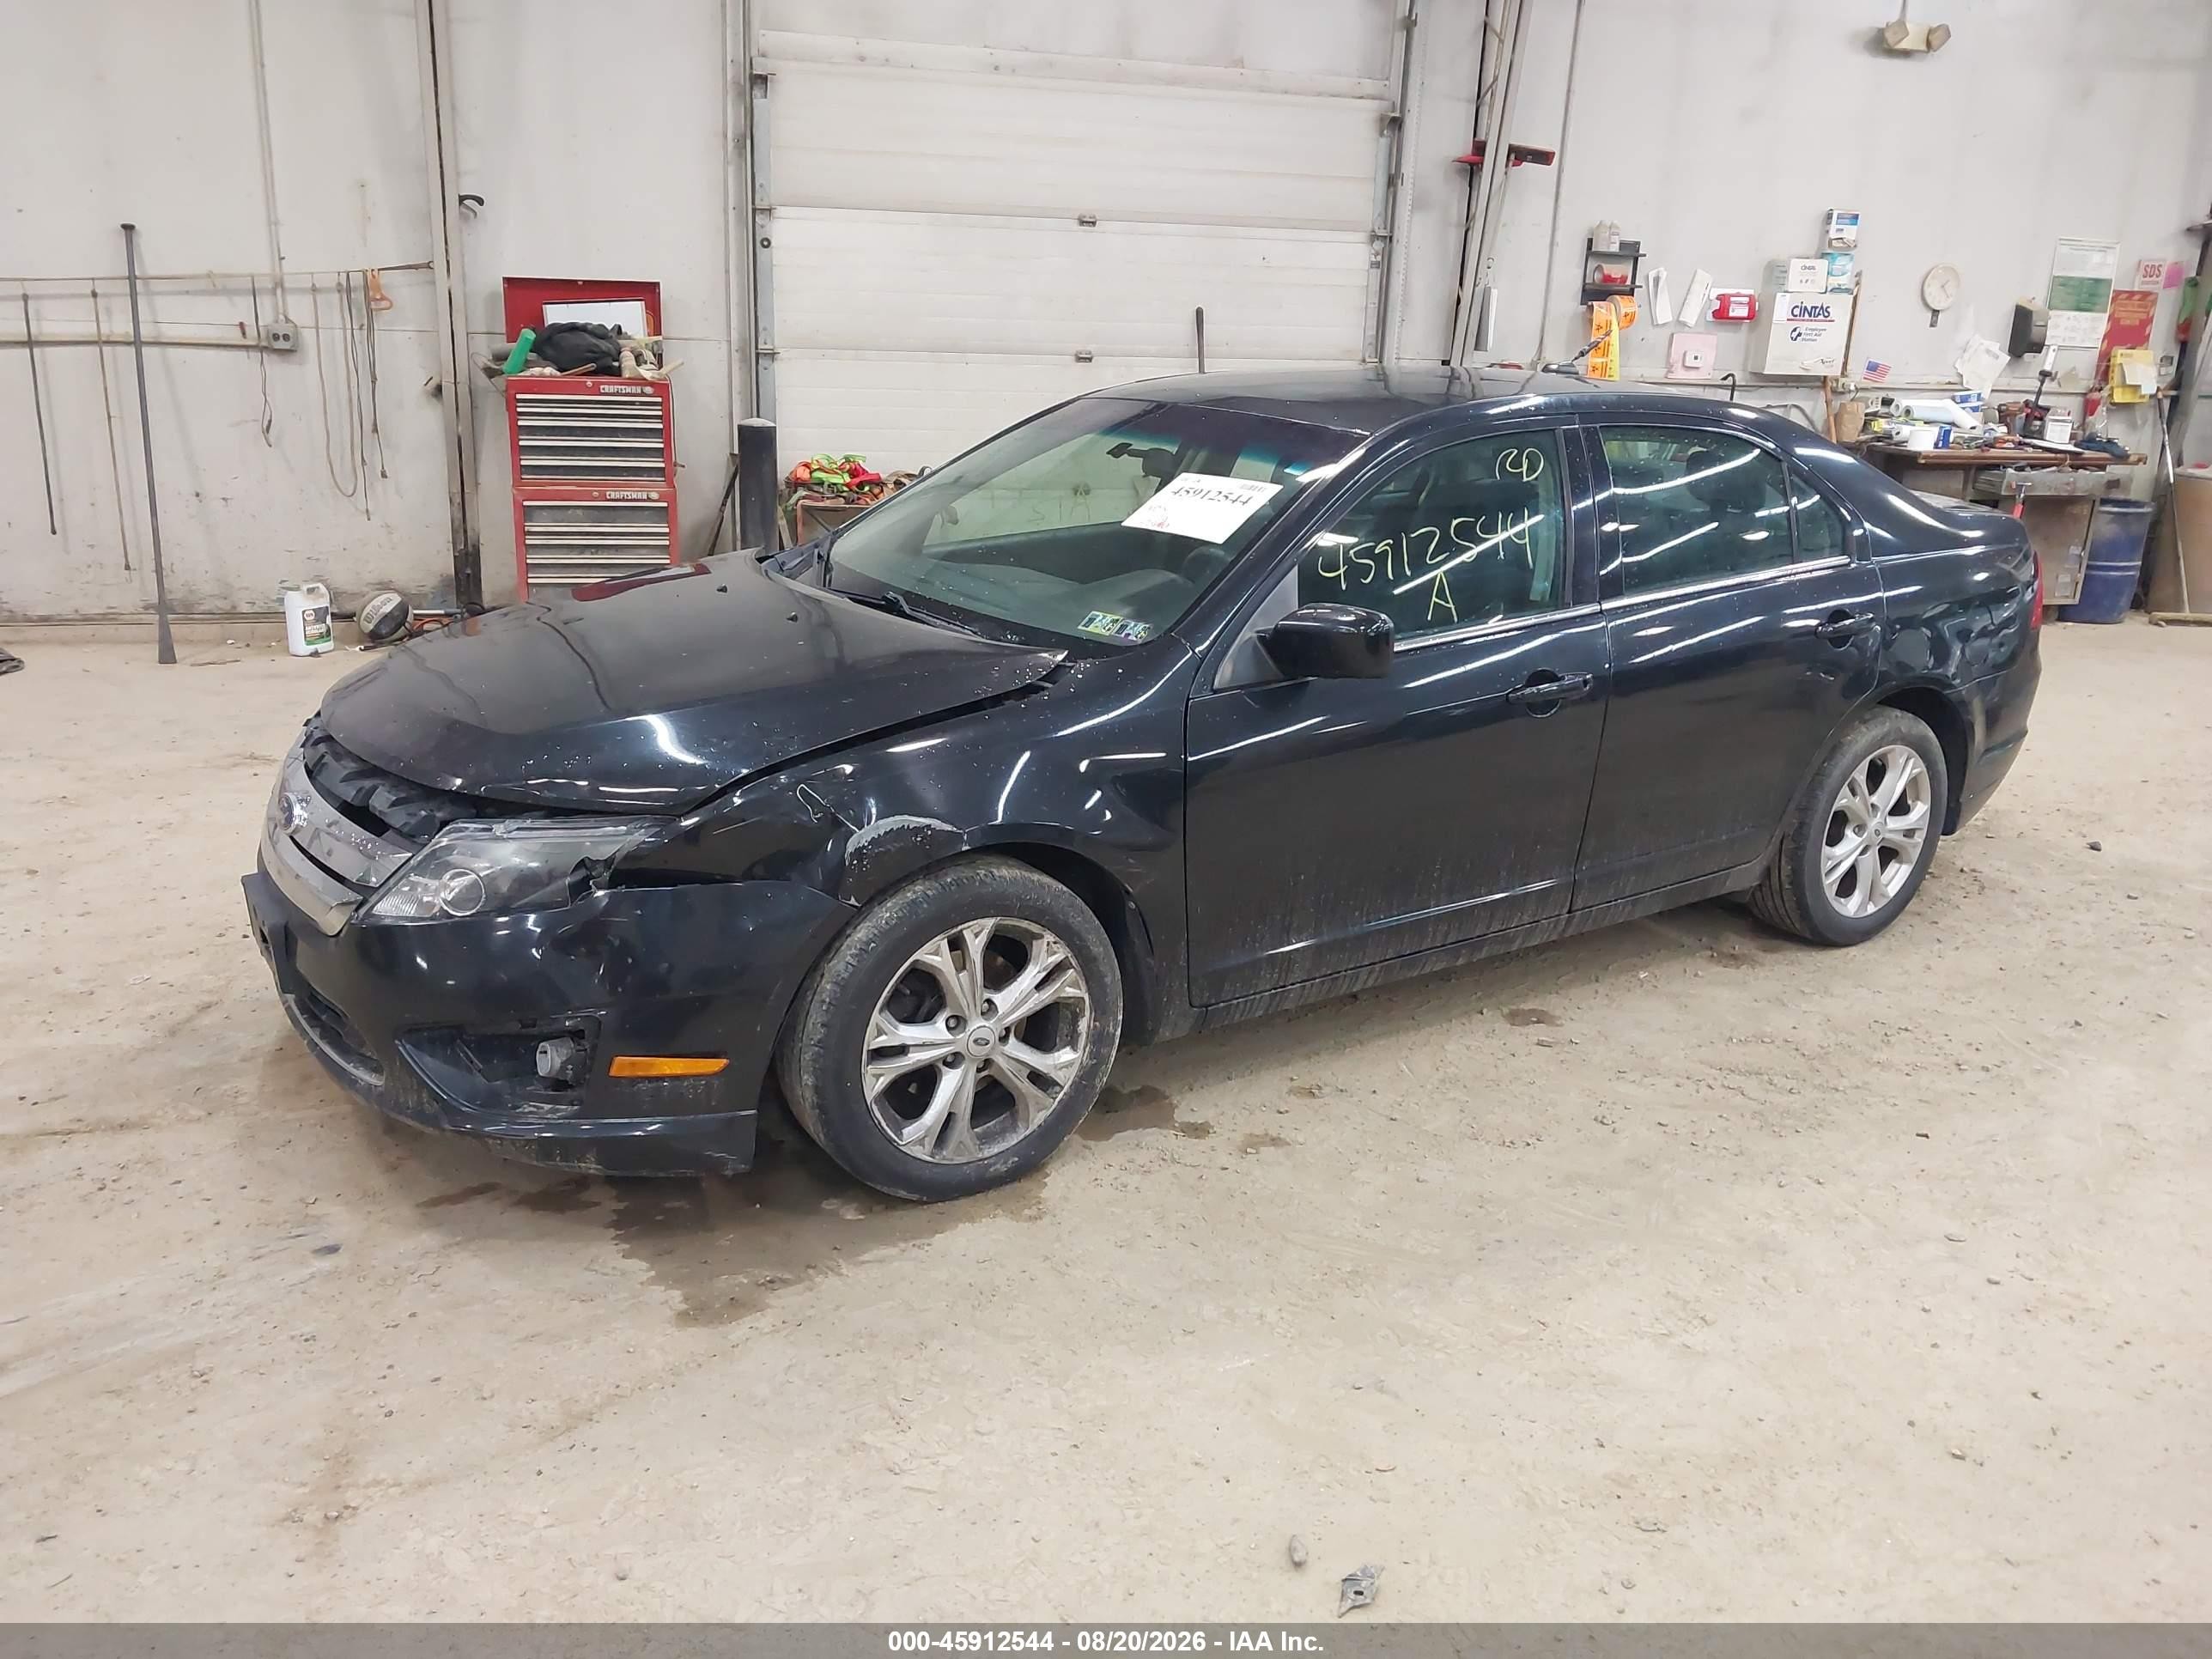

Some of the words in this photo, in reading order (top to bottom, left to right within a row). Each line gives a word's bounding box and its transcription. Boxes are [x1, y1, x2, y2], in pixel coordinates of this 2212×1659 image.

[2142, 264, 2162, 278] SDS
[600, 385, 641, 394] CRAFTSMAN
[606, 491, 647, 500] CRAFTSMAN
[1171, 486, 1253, 506] 45912544
[1318, 507, 1533, 591] 45912544
